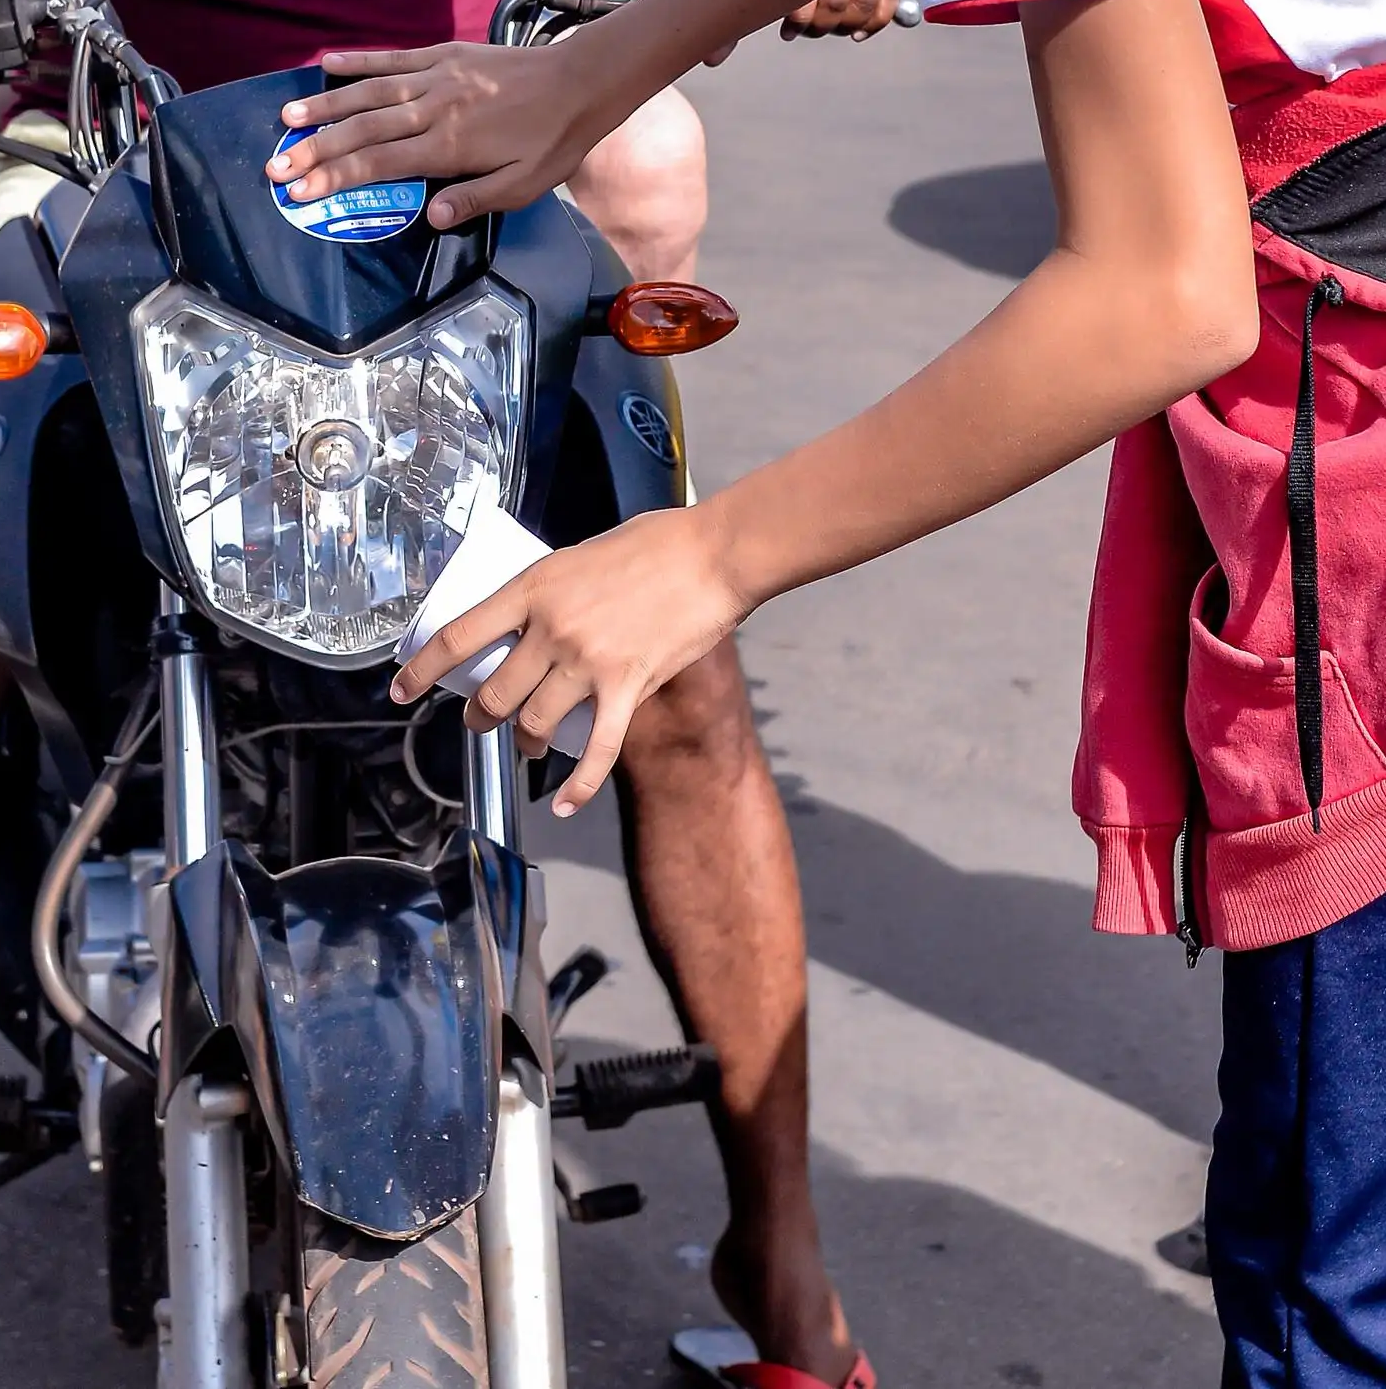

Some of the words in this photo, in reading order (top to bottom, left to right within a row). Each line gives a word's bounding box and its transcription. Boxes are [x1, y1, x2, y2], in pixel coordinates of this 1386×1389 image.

[346, 190, 375, 201] EQUIPE
[376, 189, 389, 198] DA
[357, 198, 392, 210] ESCOLAR
